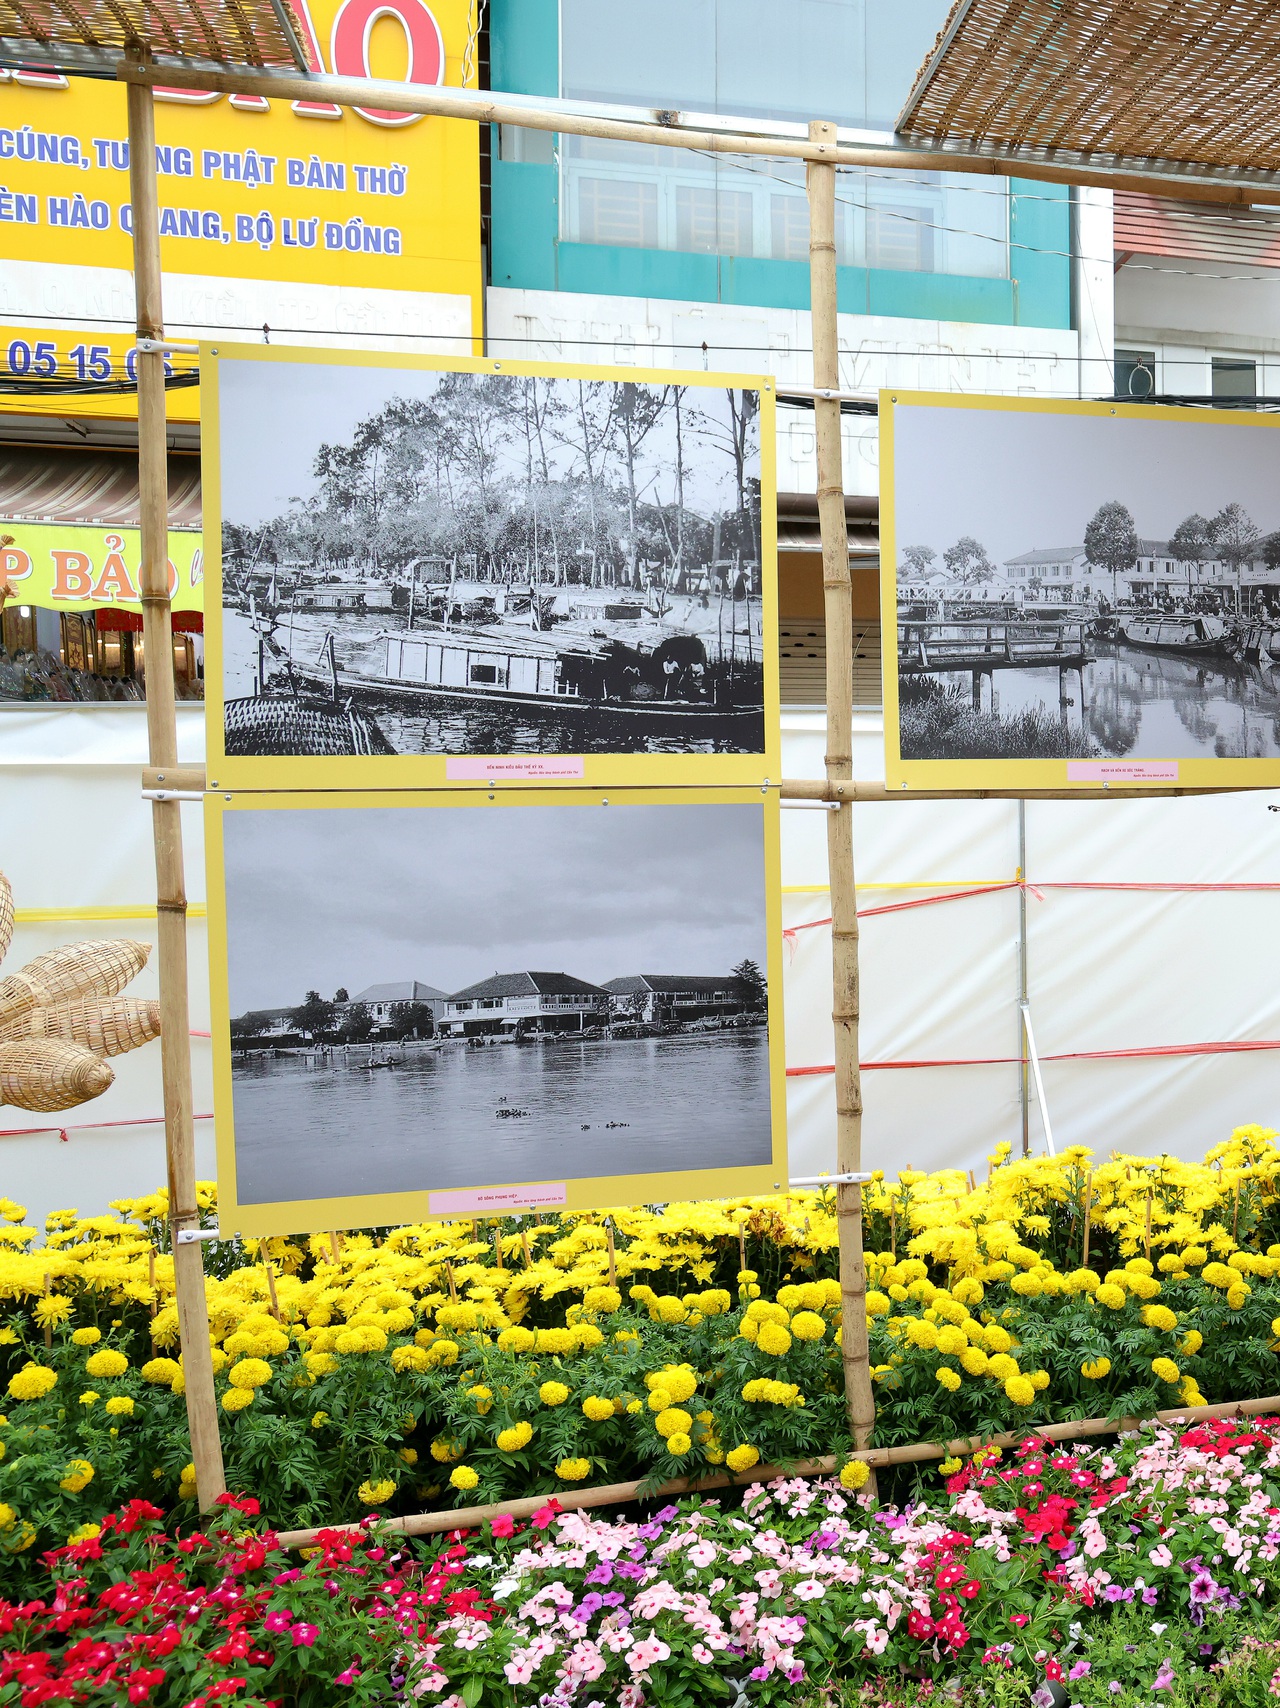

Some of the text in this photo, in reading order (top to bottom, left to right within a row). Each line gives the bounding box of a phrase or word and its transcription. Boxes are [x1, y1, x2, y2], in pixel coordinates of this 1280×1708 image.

[0, 126, 407, 195] CÚNG, TƯNG PHẬT BÀN THỜ
[49, 194, 109, 229] HÀO
[119, 204, 229, 243] QANG,
[236, 212, 274, 249] BỘ
[283, 218, 318, 247] LƯ
[325, 217, 401, 254] ĐỒNG
[8, 340, 57, 376] 05
[69, 345, 112, 381] 15
